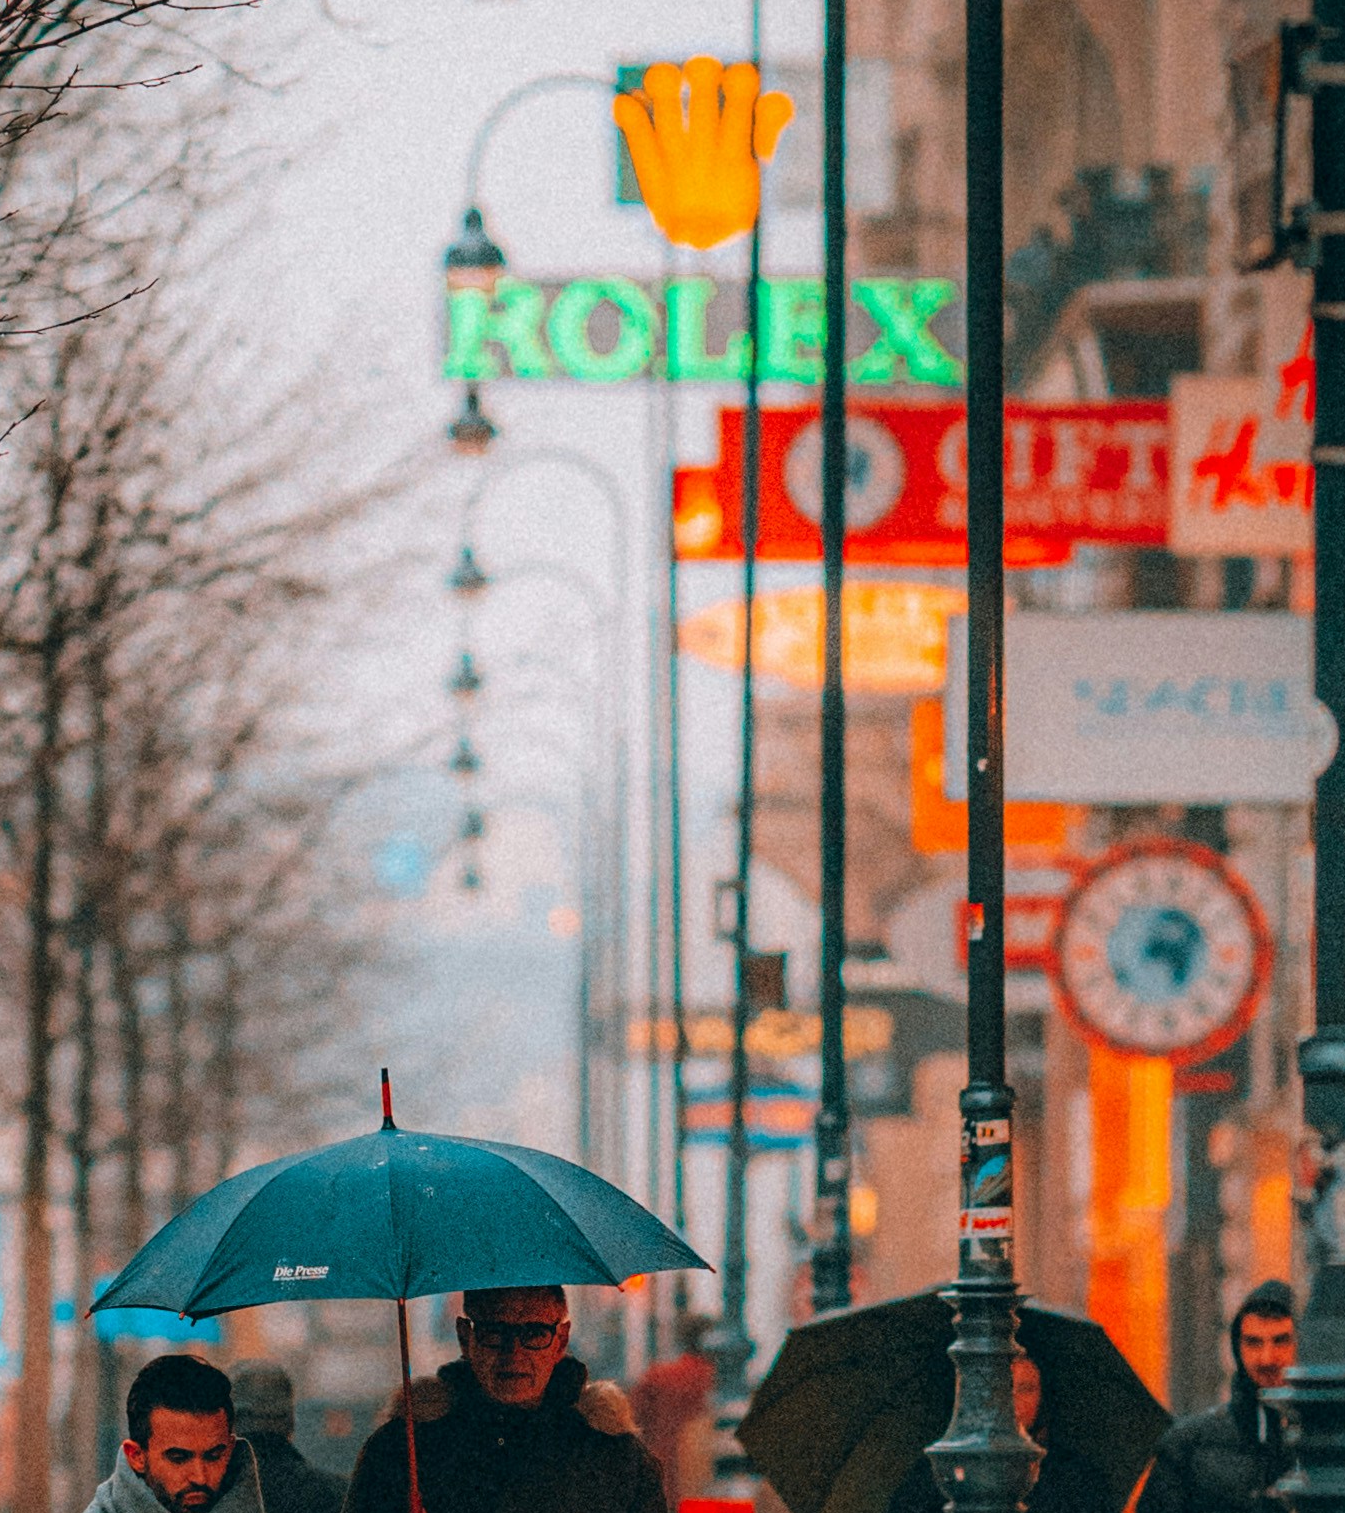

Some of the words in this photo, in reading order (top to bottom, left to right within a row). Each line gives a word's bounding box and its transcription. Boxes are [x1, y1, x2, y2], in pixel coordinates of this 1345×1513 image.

[445, 276, 964, 386] ROLEX
[274, 1266, 294, 1278] Die
[295, 1265, 329, 1276] Presse
